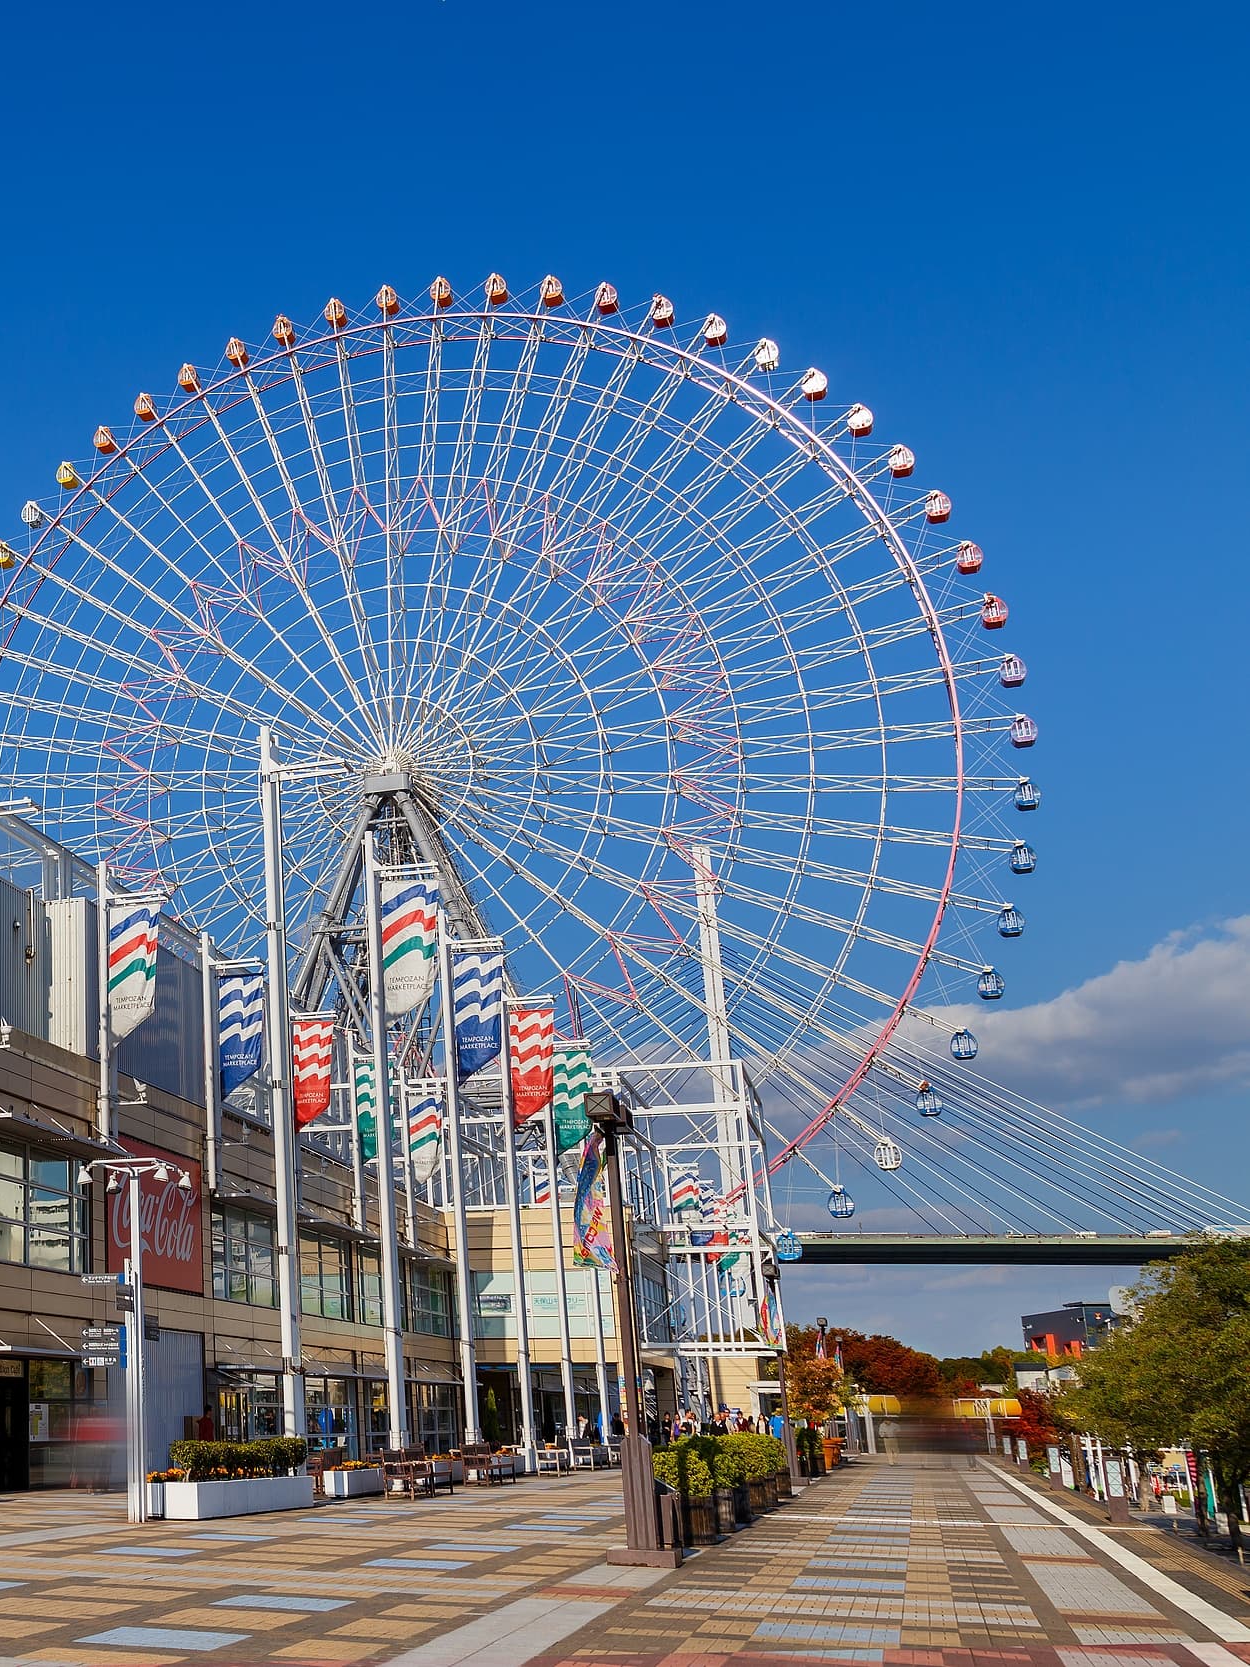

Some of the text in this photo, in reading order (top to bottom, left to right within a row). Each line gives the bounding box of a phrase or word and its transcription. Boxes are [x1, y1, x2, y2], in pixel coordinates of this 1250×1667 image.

[115, 995, 147, 1003] TEMPOZAN
[387, 983, 430, 991] MARKETPLACE
[112, 1173, 198, 1262] Coa-Cola
[578, 1207, 603, 1258] WECOME
